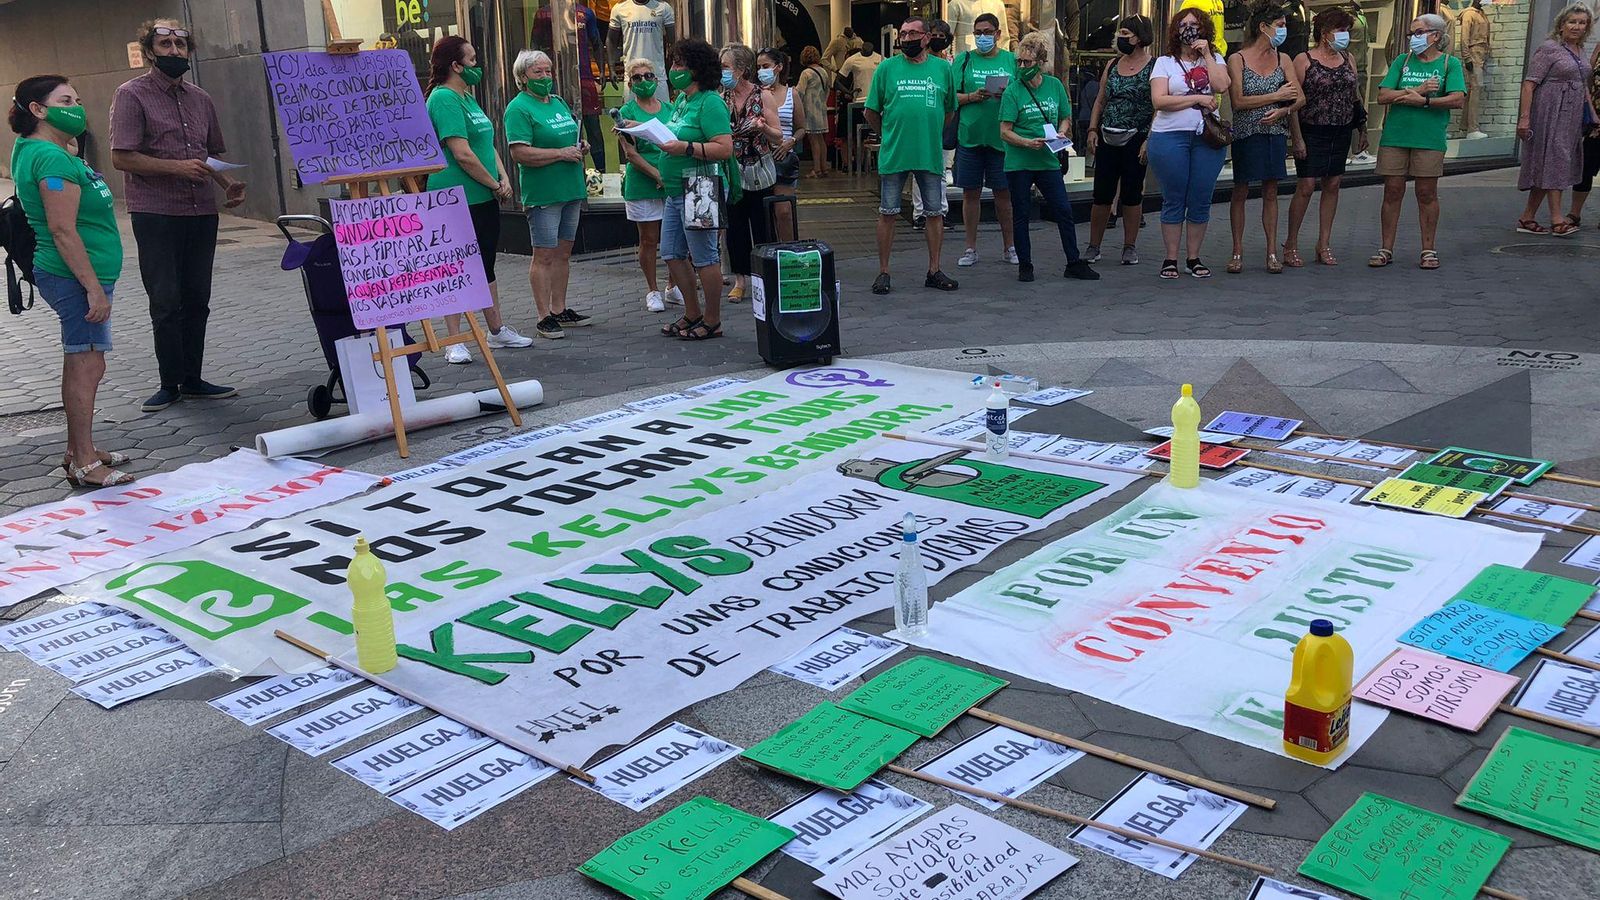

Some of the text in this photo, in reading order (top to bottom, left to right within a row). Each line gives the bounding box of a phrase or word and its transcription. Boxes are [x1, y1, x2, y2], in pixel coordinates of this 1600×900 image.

[351, 54, 407, 72] TURISMO
[328, 70, 412, 97] CONDICIONES
[285, 88, 417, 126] DIGNAS DE TRABAJO
[287, 107, 412, 146] SOMOS PARTE DEL
[324, 131, 385, 155] TURISMO
[297, 154, 359, 175] ESTAMOS
[415, 188, 459, 211] A LOS
[335, 213, 424, 246] SINDICATOS
[363, 246, 374, 265] A
[372, 235, 429, 260] FIRMAR
[372, 293, 400, 310] VAIS
[400, 286, 432, 305] HACER
[1508, 350, 1579, 361] NO
[451, 426, 508, 442] SO
[457, 445, 497, 462] HUELGA
[476, 447, 709, 517] TOCAN
[686, 433, 752, 450] A
[724, 390, 881, 434] TODAS
[519, 428, 564, 444] HUELGA
[231, 519, 361, 561] SI
[363, 434, 645, 514] TOCAN
[632, 419, 694, 436] A
[678, 390, 790, 421] UNA
[508, 466, 768, 558] KELLYS
[1370, 485, 1473, 509] Por un convenio justo
[1000, 508, 1200, 608] POR UN
[396, 488, 901, 686] KELLYS BENIDORM
[553, 514, 948, 688] POR UNAS CONDICIONES
[1073, 513, 1327, 663] CONVENIO
[1254, 553, 1415, 655] JUSTO
[8, 608, 97, 638] HUELGA
[38, 621, 130, 652] HUELGA
[667, 644, 741, 679] DE
[736, 571, 896, 639] TRABAJO
[68, 635, 161, 668] HUELGA
[793, 640, 869, 675] HUELGA
[98, 658, 194, 695] HUELGA
[235, 672, 330, 709] HUELGA
[855, 673, 898, 706] AYUDAS
[1365, 659, 1420, 701] TOD@S
[1406, 664, 1451, 704] SOMOS
[1425, 670, 1483, 719] TURISMO
[1544, 675, 1600, 718] HUELGA
[295, 697, 392, 739] HUELGA
[515, 701, 610, 736] HOTEL
[361, 728, 462, 772] HUELGA
[603, 741, 699, 787] HUELGA
[947, 740, 1039, 786] HUELGA
[421, 757, 524, 807] HUELGA
[789, 792, 885, 847] HUELGA
[582, 858, 606, 874] EL
[607, 817, 676, 857] TURISMO
[649, 880, 672, 899] NO
[691, 820, 761, 866] TURISMO
[886, 816, 968, 866] AYUDAS
